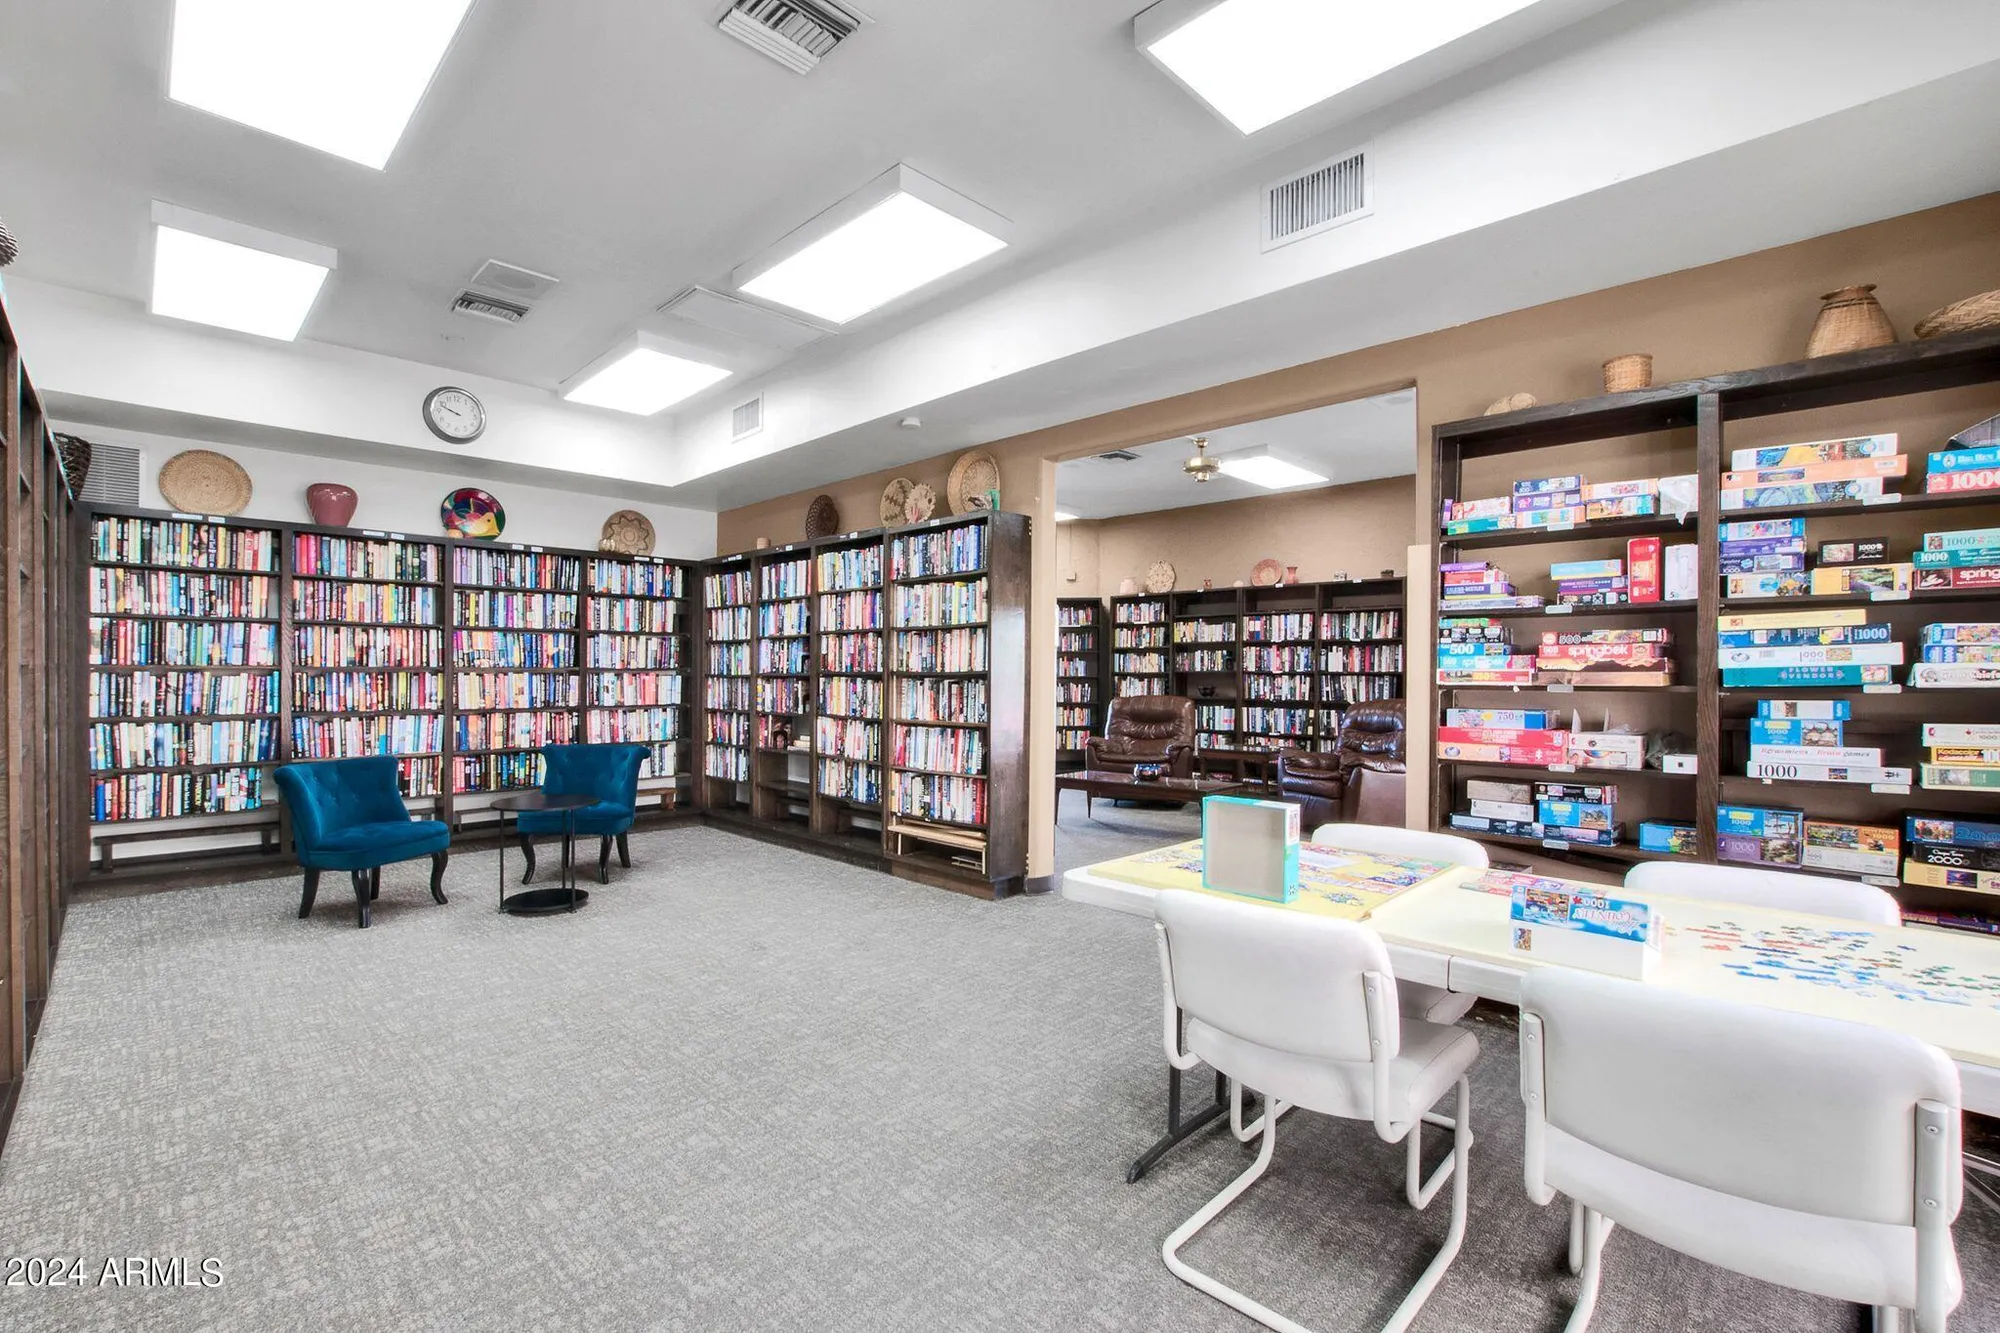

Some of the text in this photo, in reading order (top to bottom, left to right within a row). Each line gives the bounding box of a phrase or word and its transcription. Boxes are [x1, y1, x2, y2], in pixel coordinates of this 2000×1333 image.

[1944, 535, 1976, 547] 1000
[1919, 552, 1948, 562] 1000
[1559, 634, 1581, 645] 500
[1856, 628, 1887, 640] 1000
[1449, 644, 1475, 655] 500
[1800, 651, 1824, 662] 1000
[1498, 711, 1515, 721] 750
[1758, 764, 1797, 778] 1000
[1732, 841, 1755, 851] 1000
